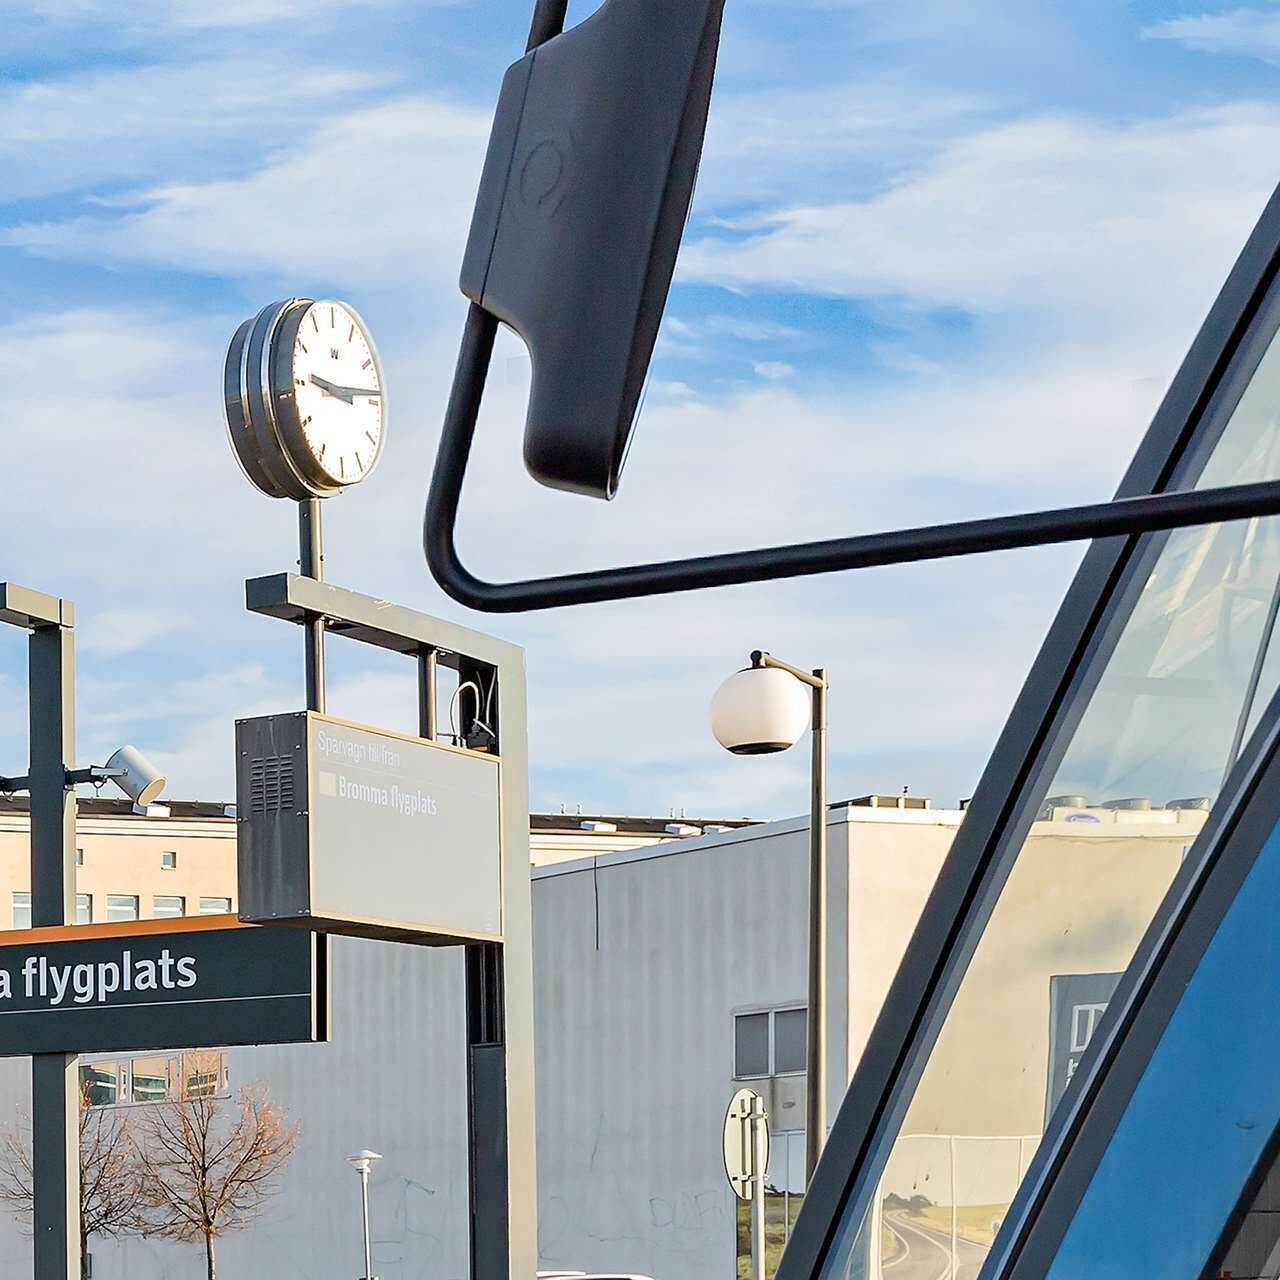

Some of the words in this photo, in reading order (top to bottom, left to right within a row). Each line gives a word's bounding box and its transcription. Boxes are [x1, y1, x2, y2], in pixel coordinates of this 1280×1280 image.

[339, 775, 388, 805] Bromma
[391, 784, 437, 816] flygplats
[22, 949, 197, 1005] flygplats
